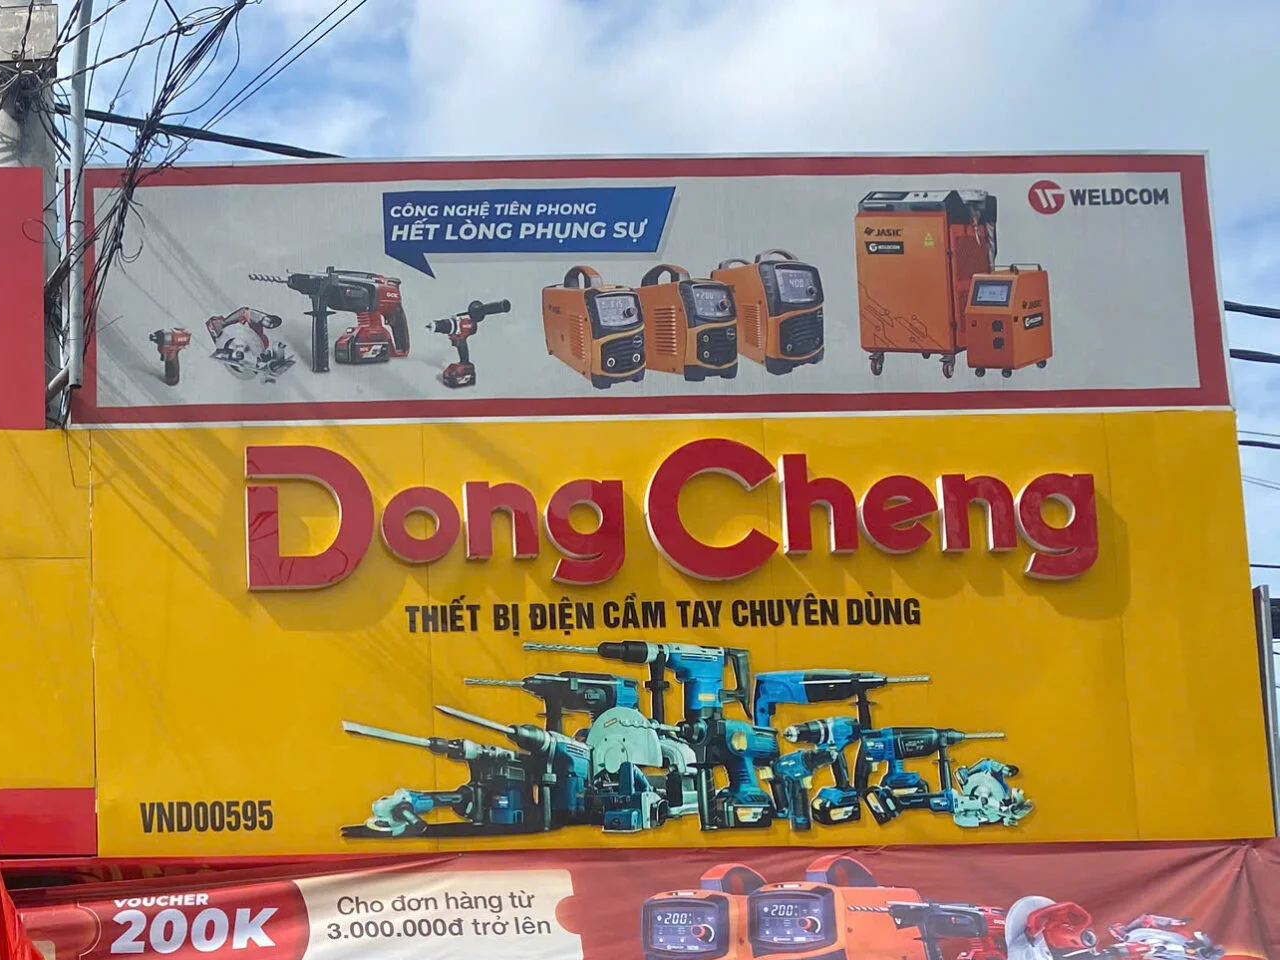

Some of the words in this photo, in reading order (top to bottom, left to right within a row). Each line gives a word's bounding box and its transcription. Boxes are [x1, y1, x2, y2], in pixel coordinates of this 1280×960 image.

[390, 203, 439, 218] CÔNG
[442, 201, 490, 219] NGHỆ
[494, 201, 532, 216] TIÊN
[535, 203, 597, 216] PHONG
[1070, 187, 1169, 206] WELDCOM
[391, 218, 440, 241] HẾT
[445, 218, 512, 240] LÒNG
[519, 221, 607, 243] PHỤNG
[612, 217, 648, 243] SỰ
[405, 593, 484, 635] THIẾT
[492, 603, 521, 640] BỊ
[528, 594, 595, 639] ĐIỆN
[602, 592, 668, 631] CẦM
[676, 600, 723, 629] TAY
[730, 592, 842, 629] CHUYÊN
[846, 590, 921, 627] DÙNG
[140, 800, 274, 833] VND00595
[113, 892, 209, 909] VOUCHER
[336, 894, 388, 916] Cho
[393, 892, 442, 914] đơn
[446, 890, 506, 918] hàng
[510, 889, 537, 910] từ
[111, 906, 279, 955] 200K
[326, 917, 464, 941] 3.000.000đ
[471, 912, 512, 937] trở
[515, 914, 552, 936] lên
